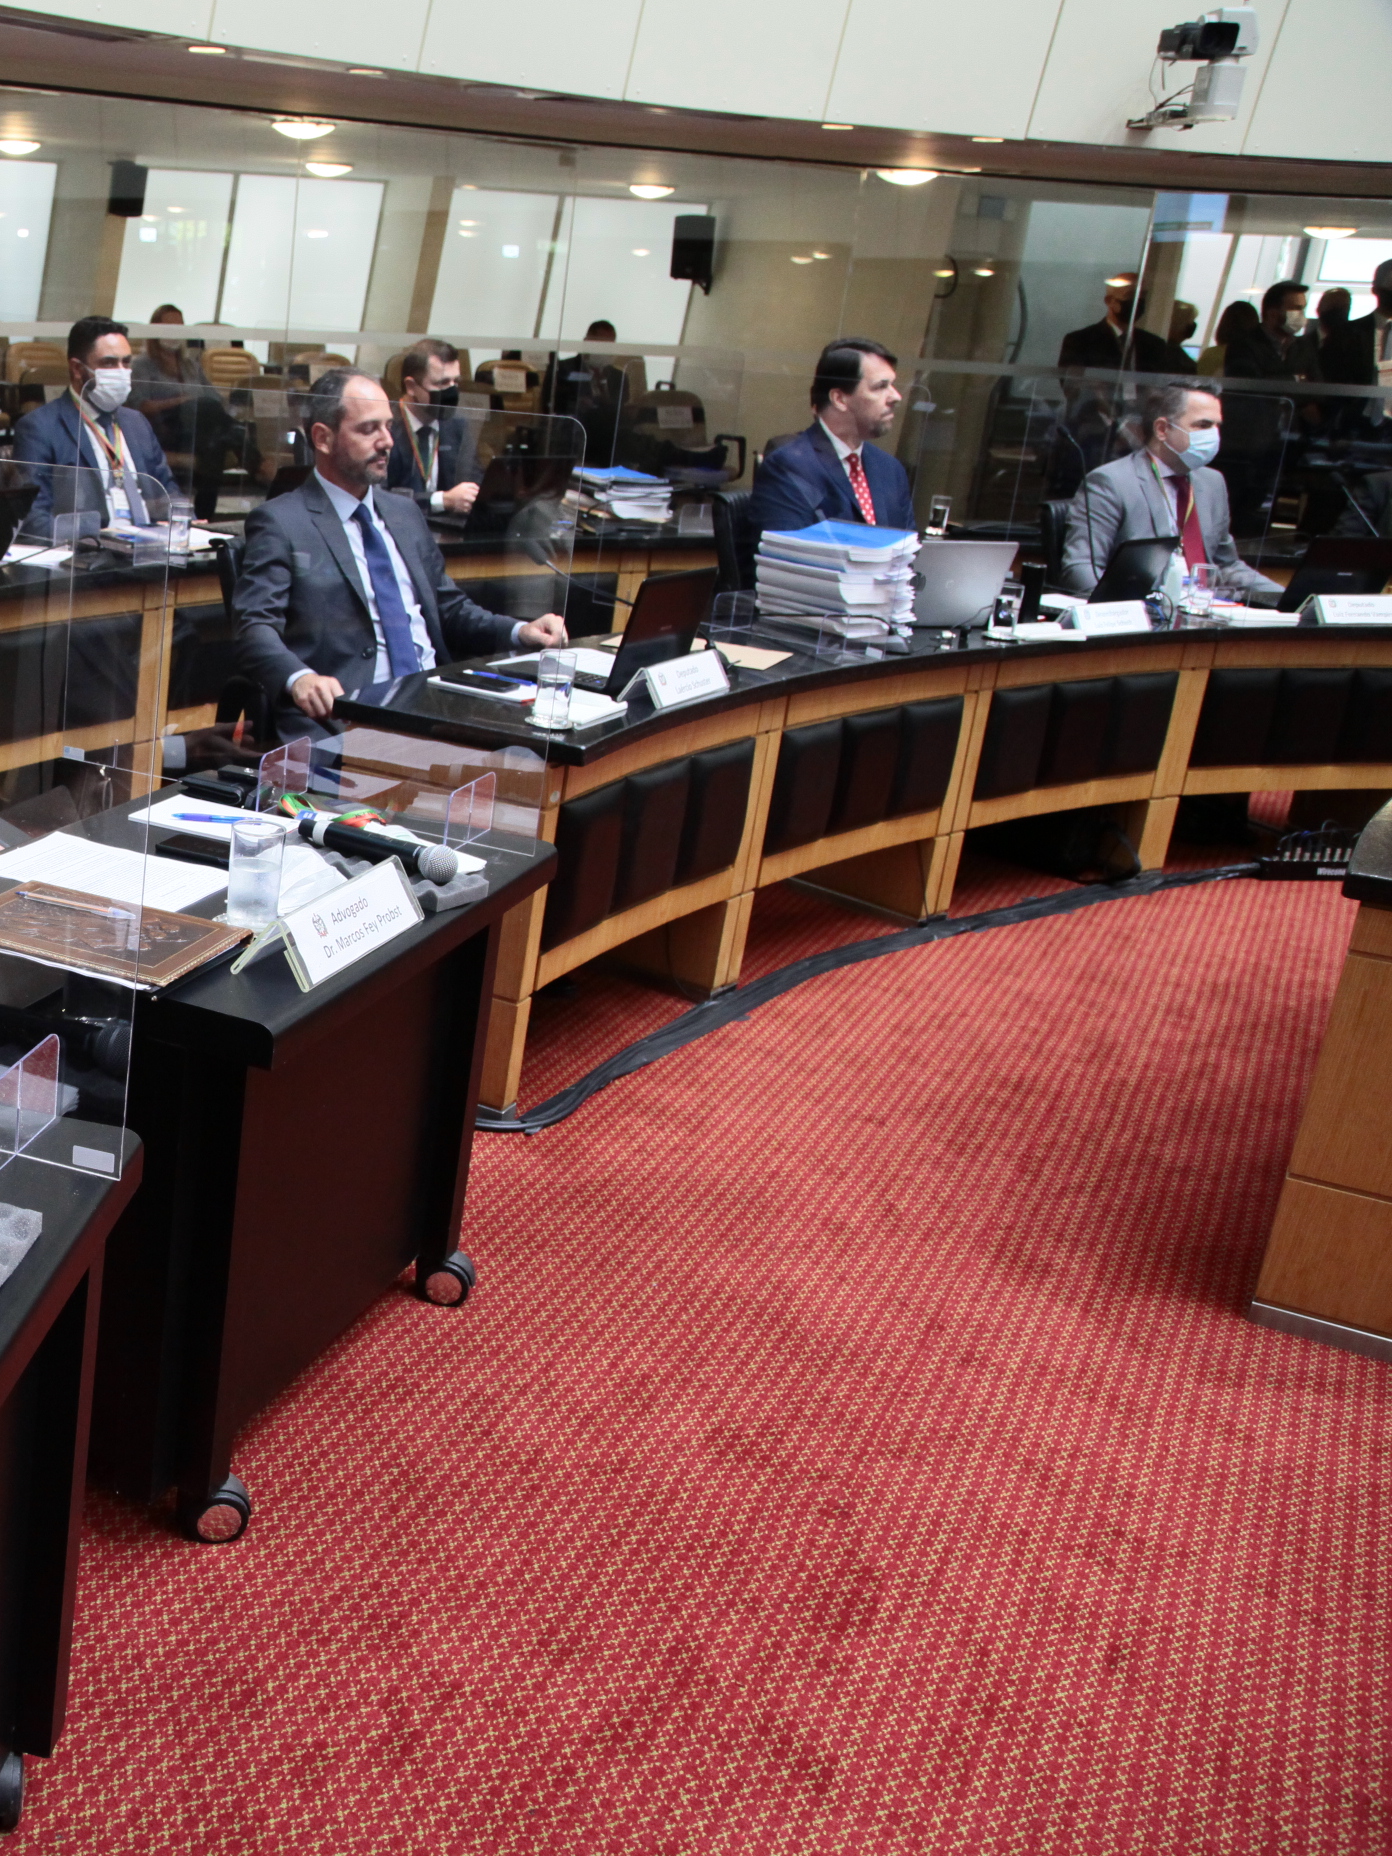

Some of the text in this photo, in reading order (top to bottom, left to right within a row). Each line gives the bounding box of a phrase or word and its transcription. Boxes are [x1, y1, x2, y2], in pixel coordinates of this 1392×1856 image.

[675, 665, 699, 679] Deputado
[330, 896, 369, 926] Advogado
[323, 904, 403, 959] Dr. Marcos Fey Probst
